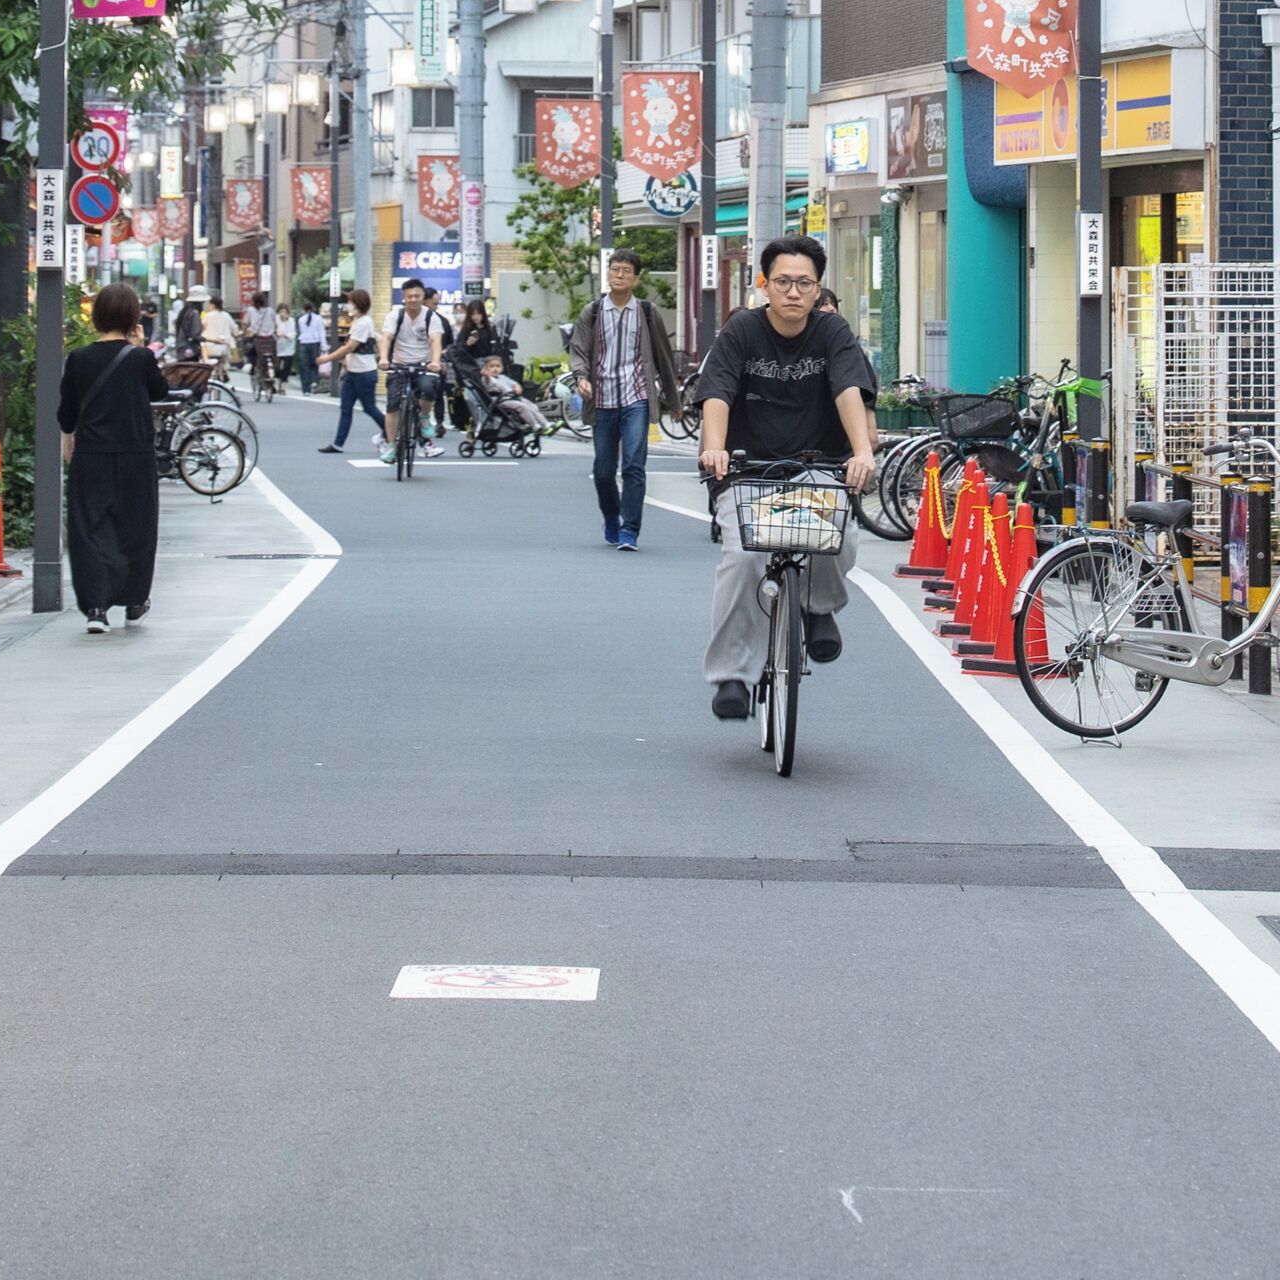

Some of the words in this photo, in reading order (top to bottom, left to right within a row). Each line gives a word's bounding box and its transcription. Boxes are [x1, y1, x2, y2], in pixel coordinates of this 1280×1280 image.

[976, 43, 1071, 80] 大森町共栄会
[43, 174, 56, 262] 大森町共栄会
[1087, 218, 1100, 292] 大森町共栄会
